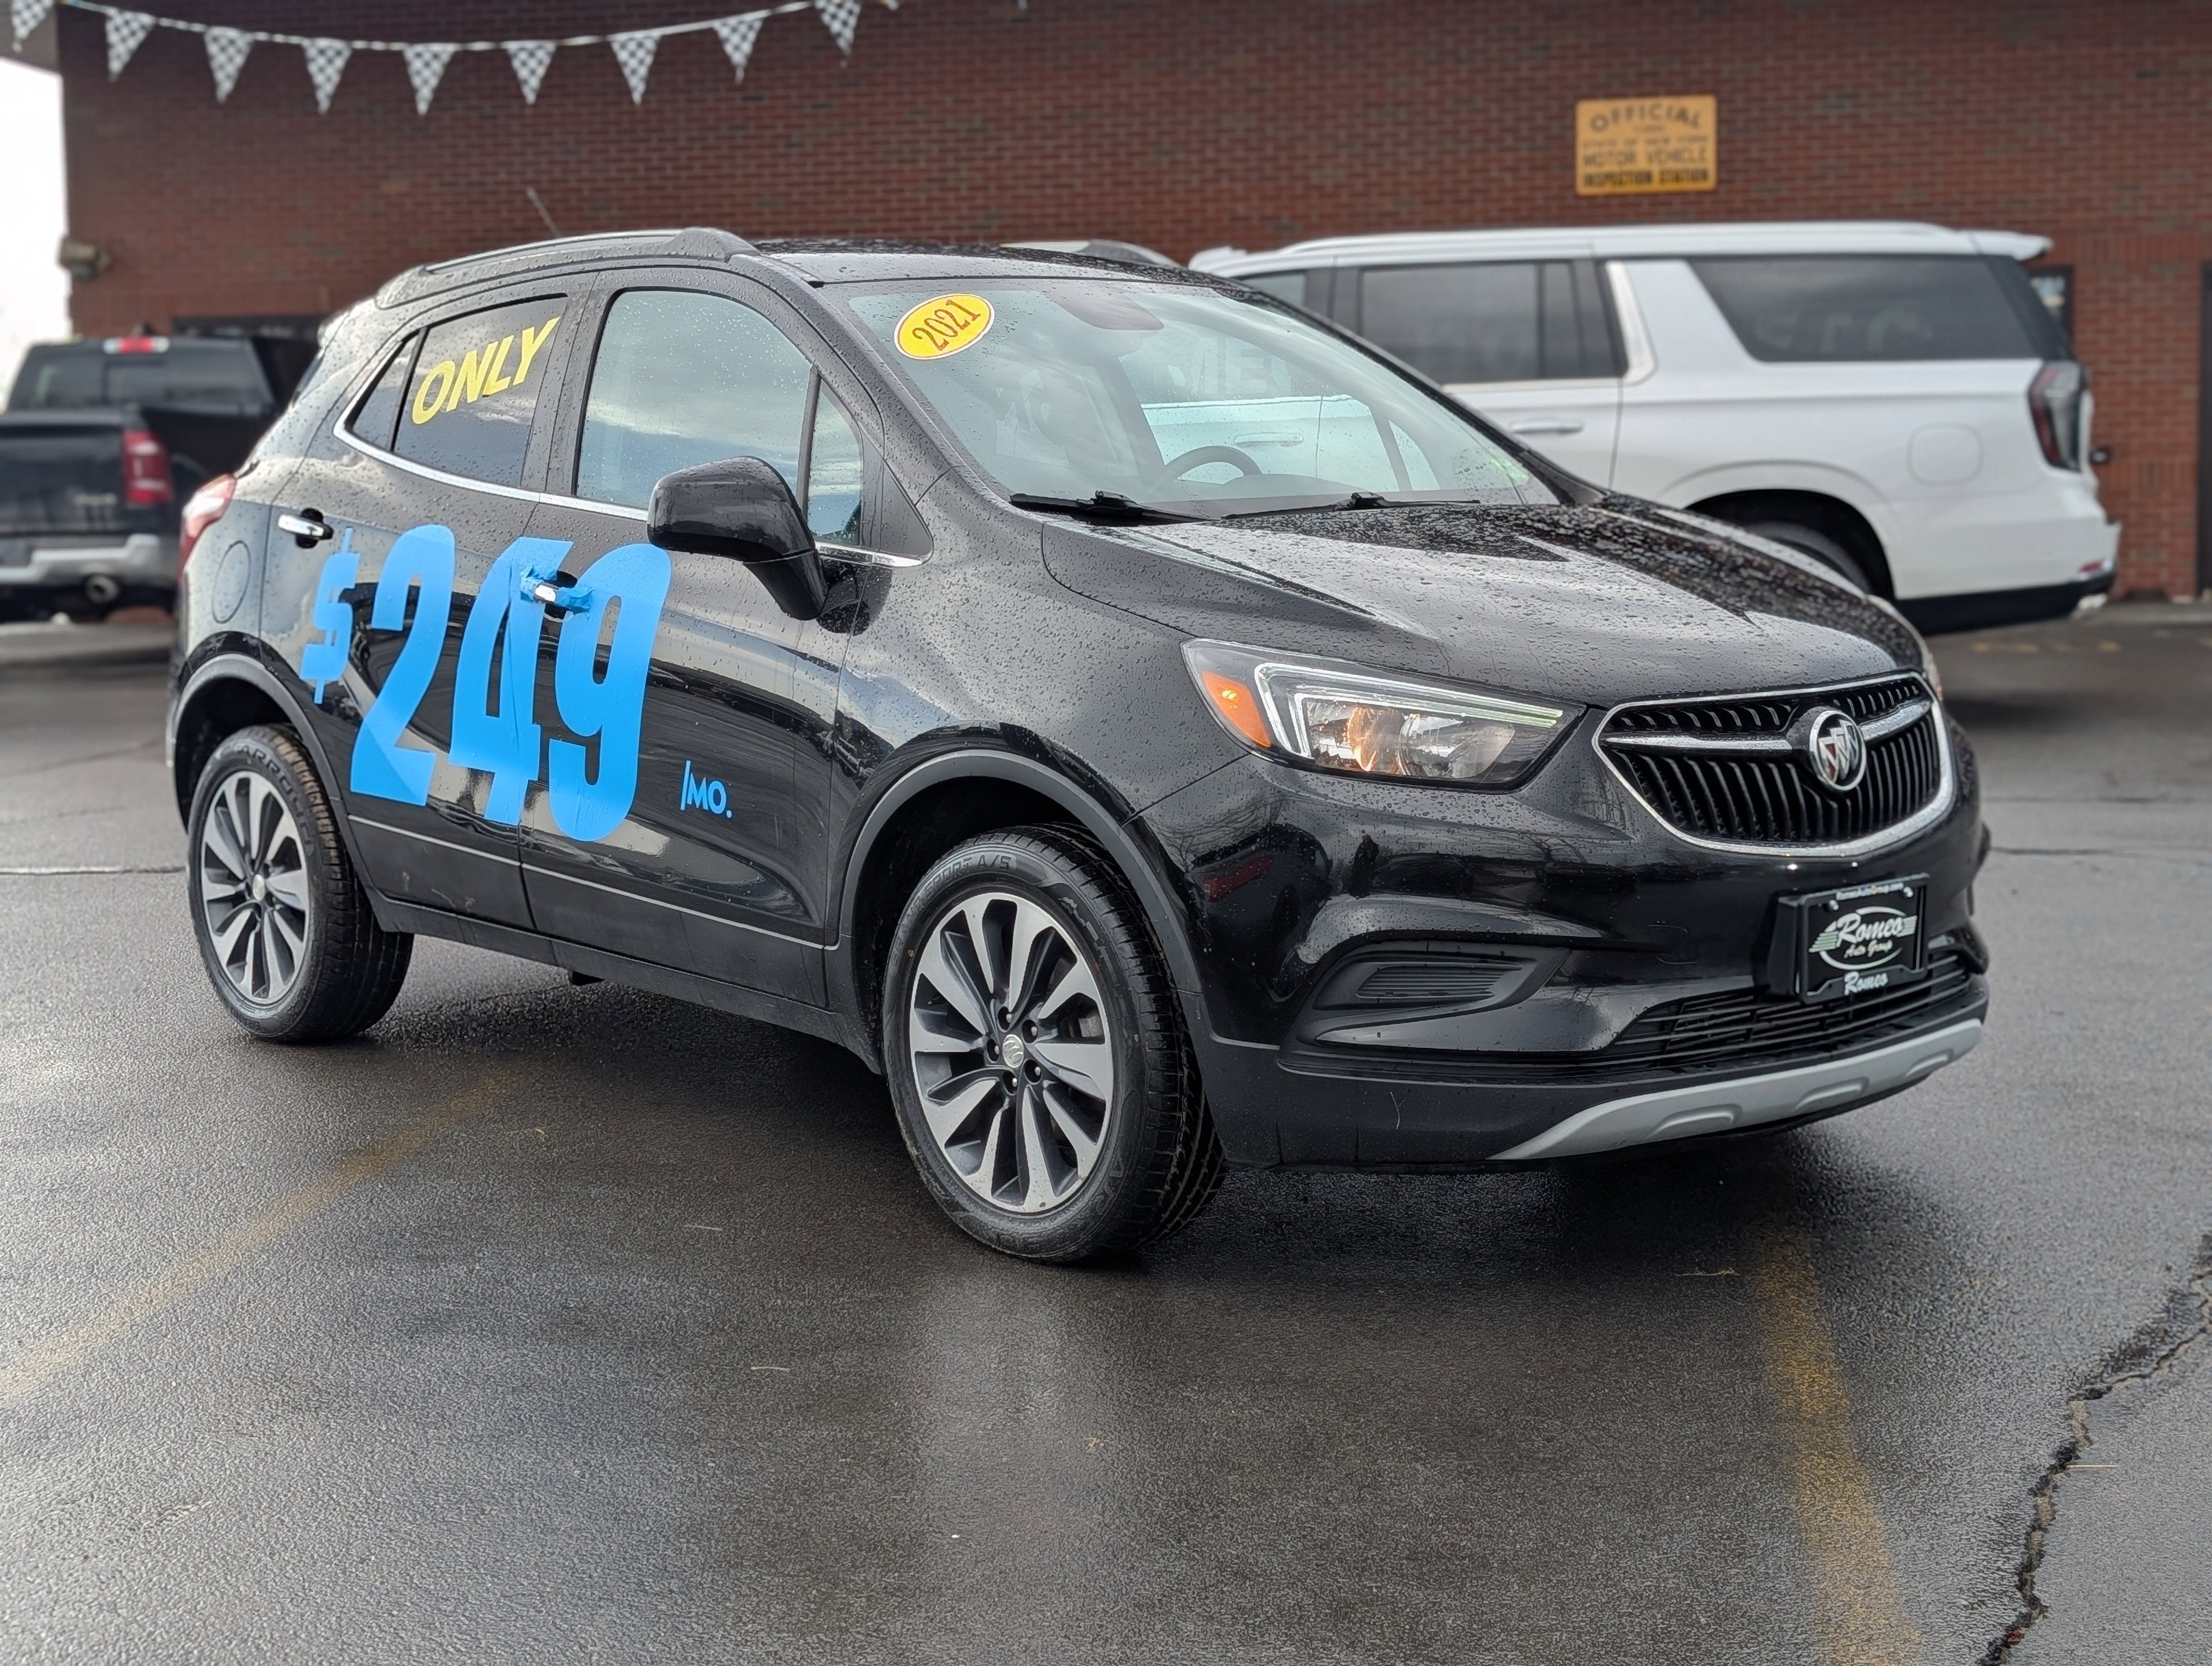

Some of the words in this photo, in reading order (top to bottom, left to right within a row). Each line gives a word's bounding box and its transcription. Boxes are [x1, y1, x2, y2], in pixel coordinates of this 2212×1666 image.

[1590, 102, 1701, 132] OFFICIAL
[912, 299, 981, 350] 2021
[412, 316, 561, 425] ONLY
[300, 524, 672, 842] $249
[976, 854, 1011, 870] A/S
[1836, 912, 1905, 948] Romeo
[1844, 971, 1888, 996] Romeo
